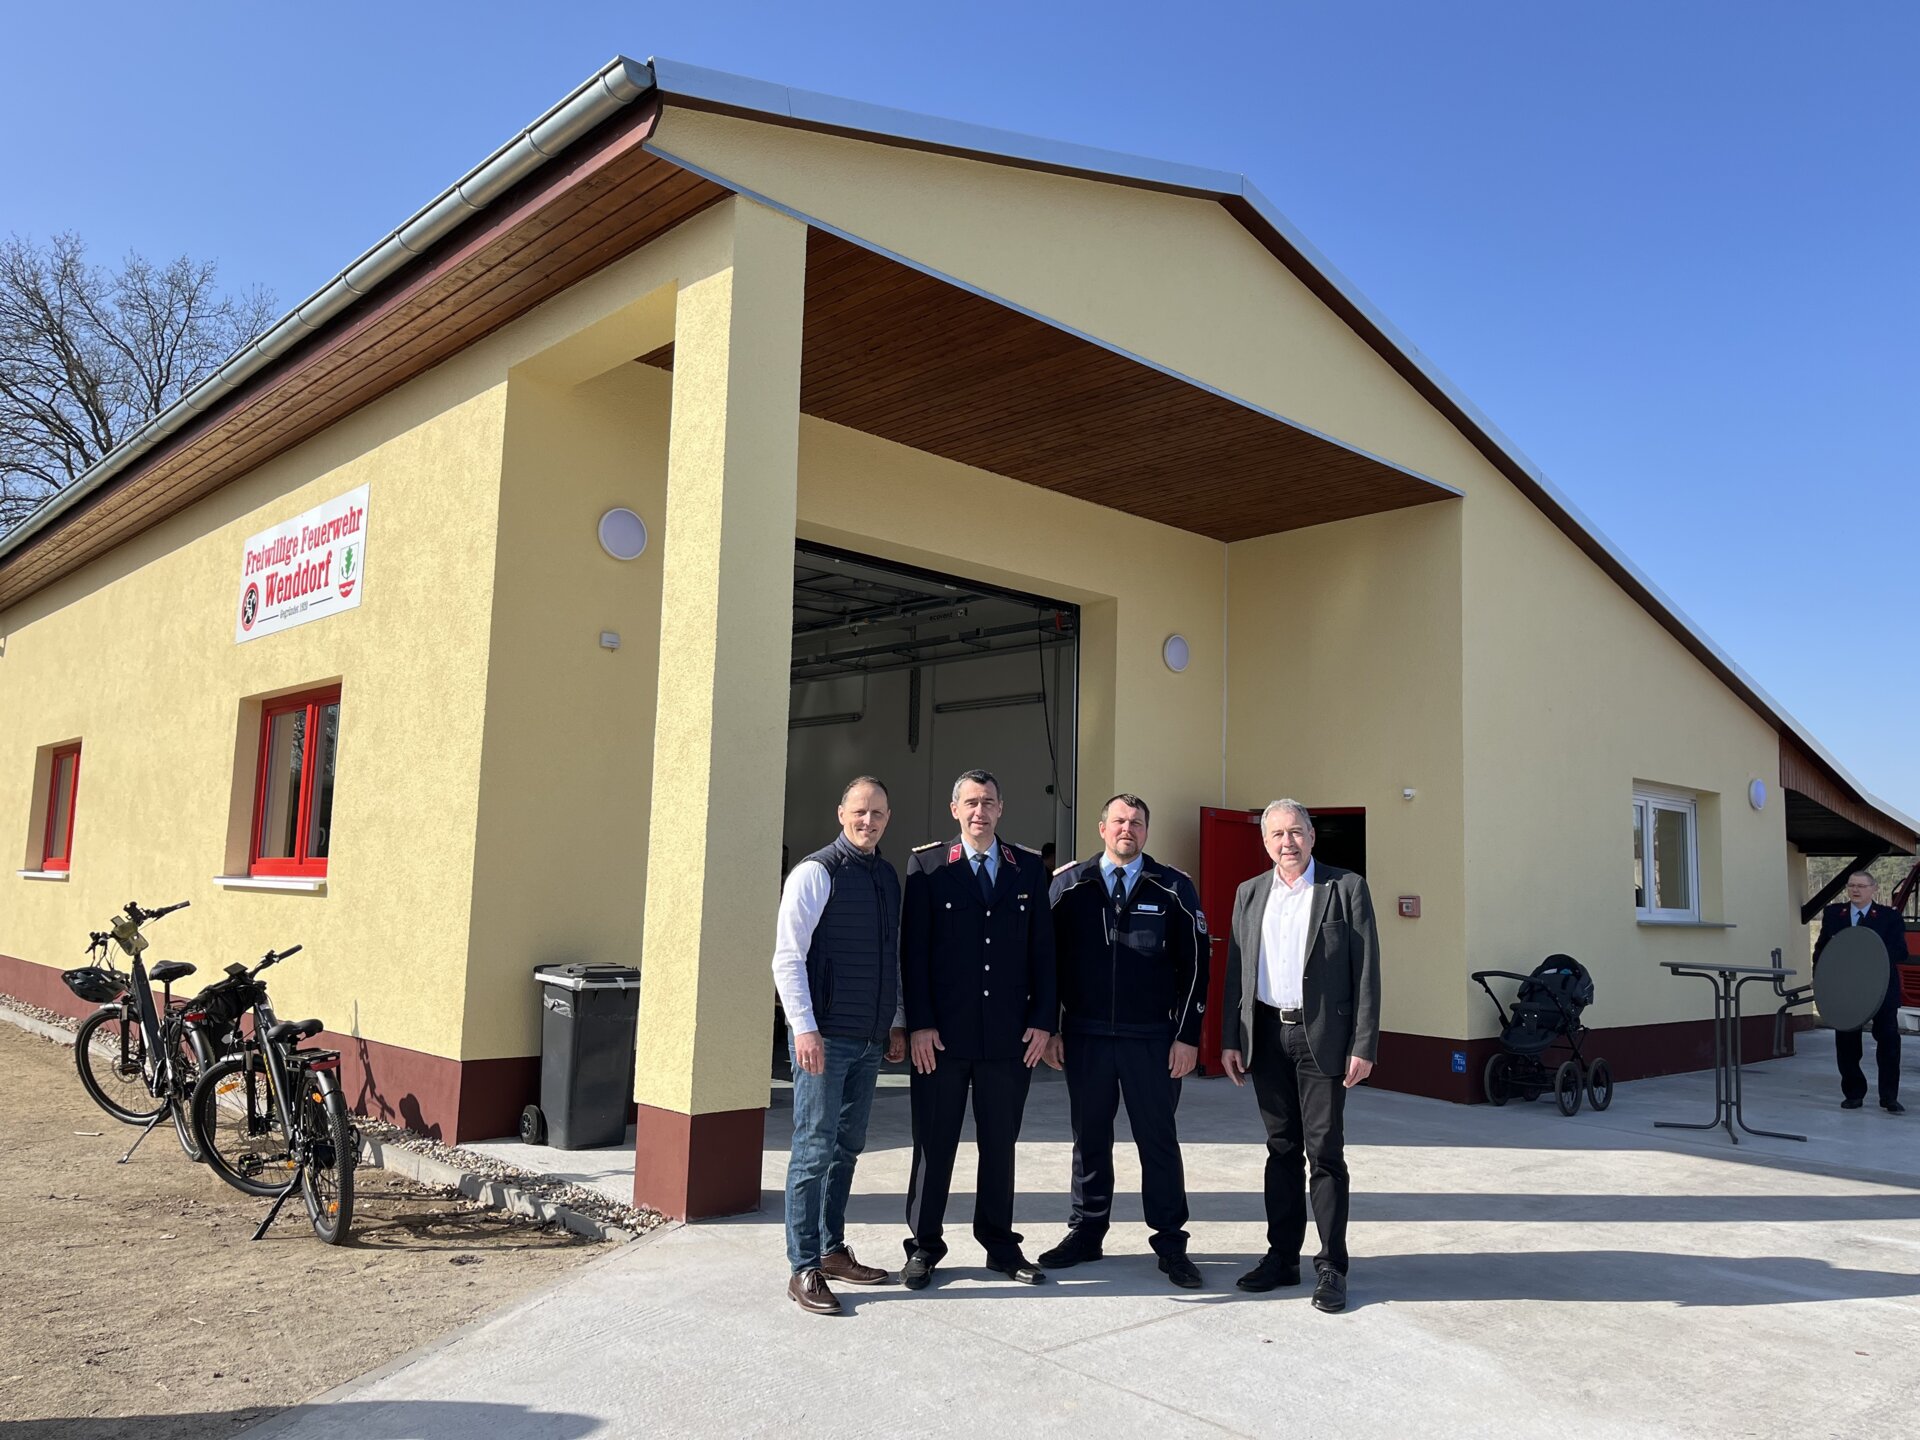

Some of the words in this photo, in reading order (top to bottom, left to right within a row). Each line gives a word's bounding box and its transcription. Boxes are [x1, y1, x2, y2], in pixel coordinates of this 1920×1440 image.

[245, 535, 298, 576] Freiwillige
[300, 506, 363, 554] Feuerwehr
[265, 550, 333, 608] Wenddorf
